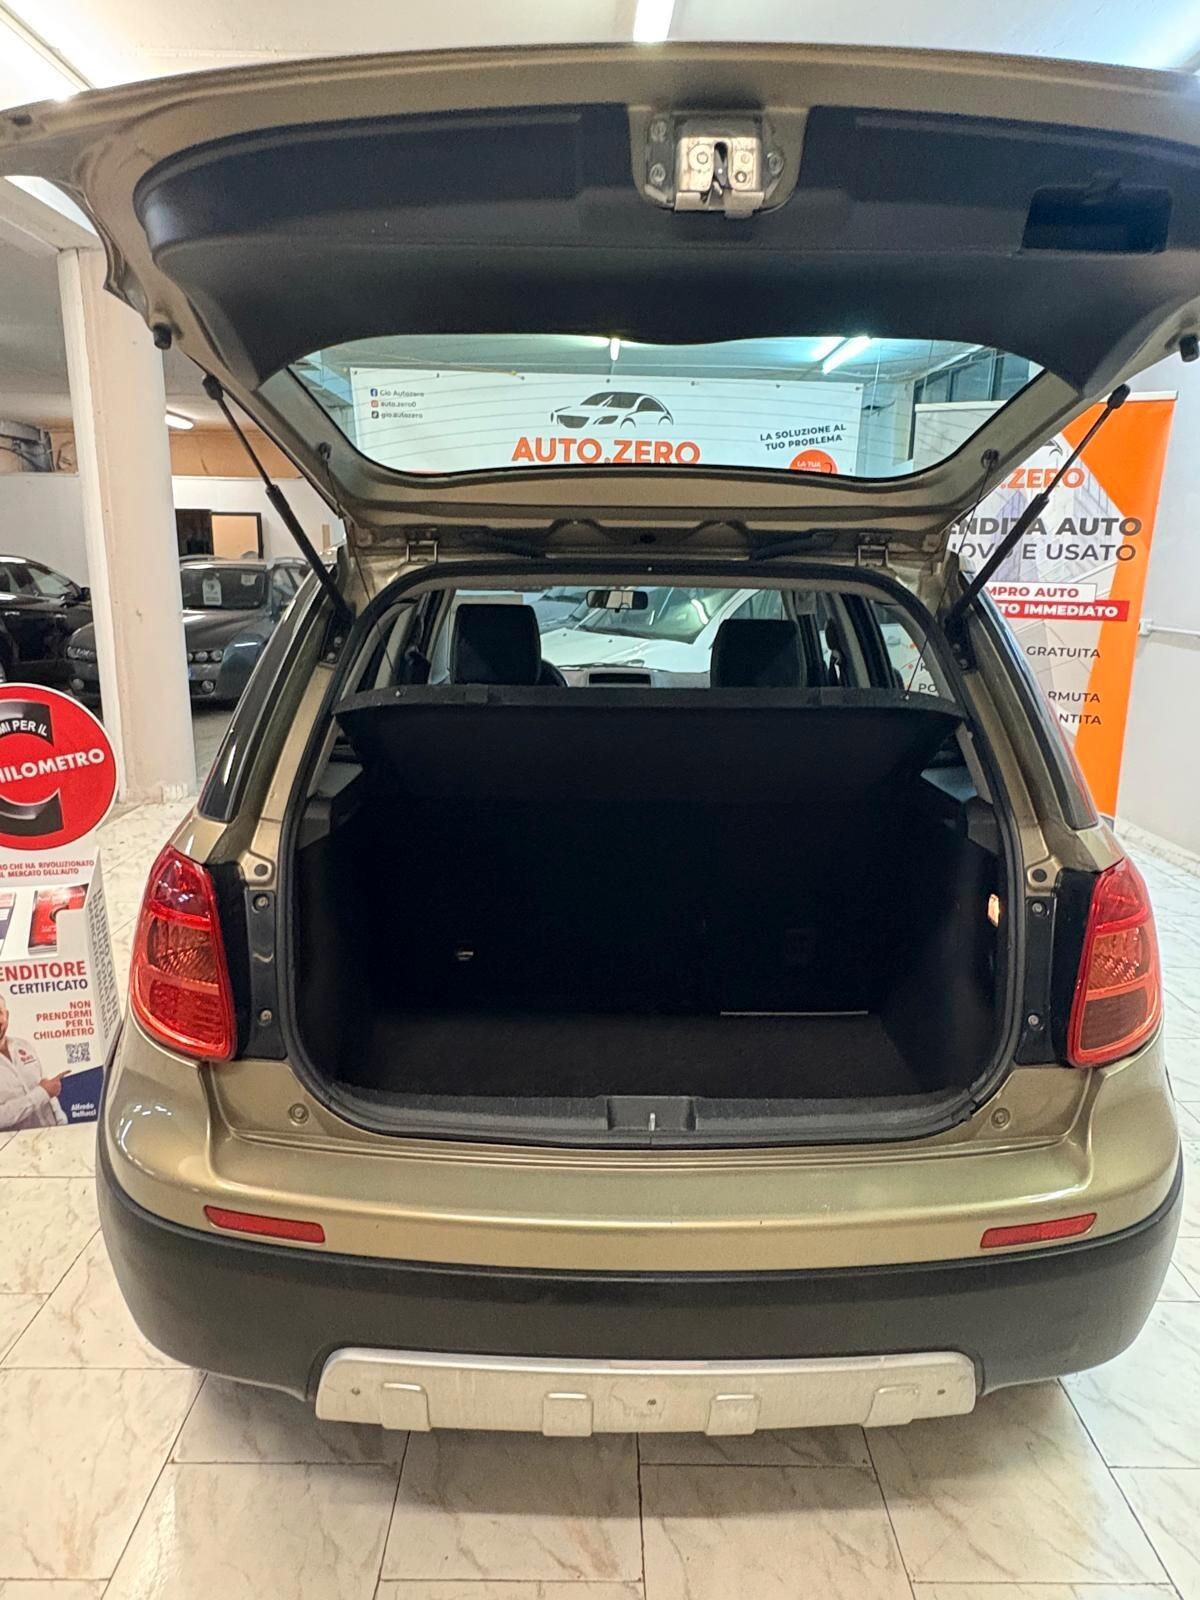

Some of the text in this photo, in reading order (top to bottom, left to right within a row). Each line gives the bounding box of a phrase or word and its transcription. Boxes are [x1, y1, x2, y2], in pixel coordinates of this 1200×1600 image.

[760, 423, 847, 441] LA SOLUZIONE AL
[511, 436, 701, 464] AUTO.ZERO
[765, 434, 843, 451] TUO PROBLEMA
[1055, 516, 1143, 537] AUTO
[1022, 543, 1037, 560] E
[1046, 543, 1137, 562] USATO
[1034, 588, 1080, 598] AUTO
[1024, 603, 1119, 618] IMMEDIATO
[1025, 646, 1101, 659] GRATUITA
[1060, 713, 1102, 725] NTITA
[12, 719, 37, 732] PER
[37, 723, 48, 737] IL
[10, 978, 89, 995] CERTIFICATO
[69, 999, 92, 1010] NON
[36, 1009, 93, 1023] PRENDERMI
[65, 1018, 94, 1029] PER IL
[33, 1026, 95, 1041] CHILOMETRO
